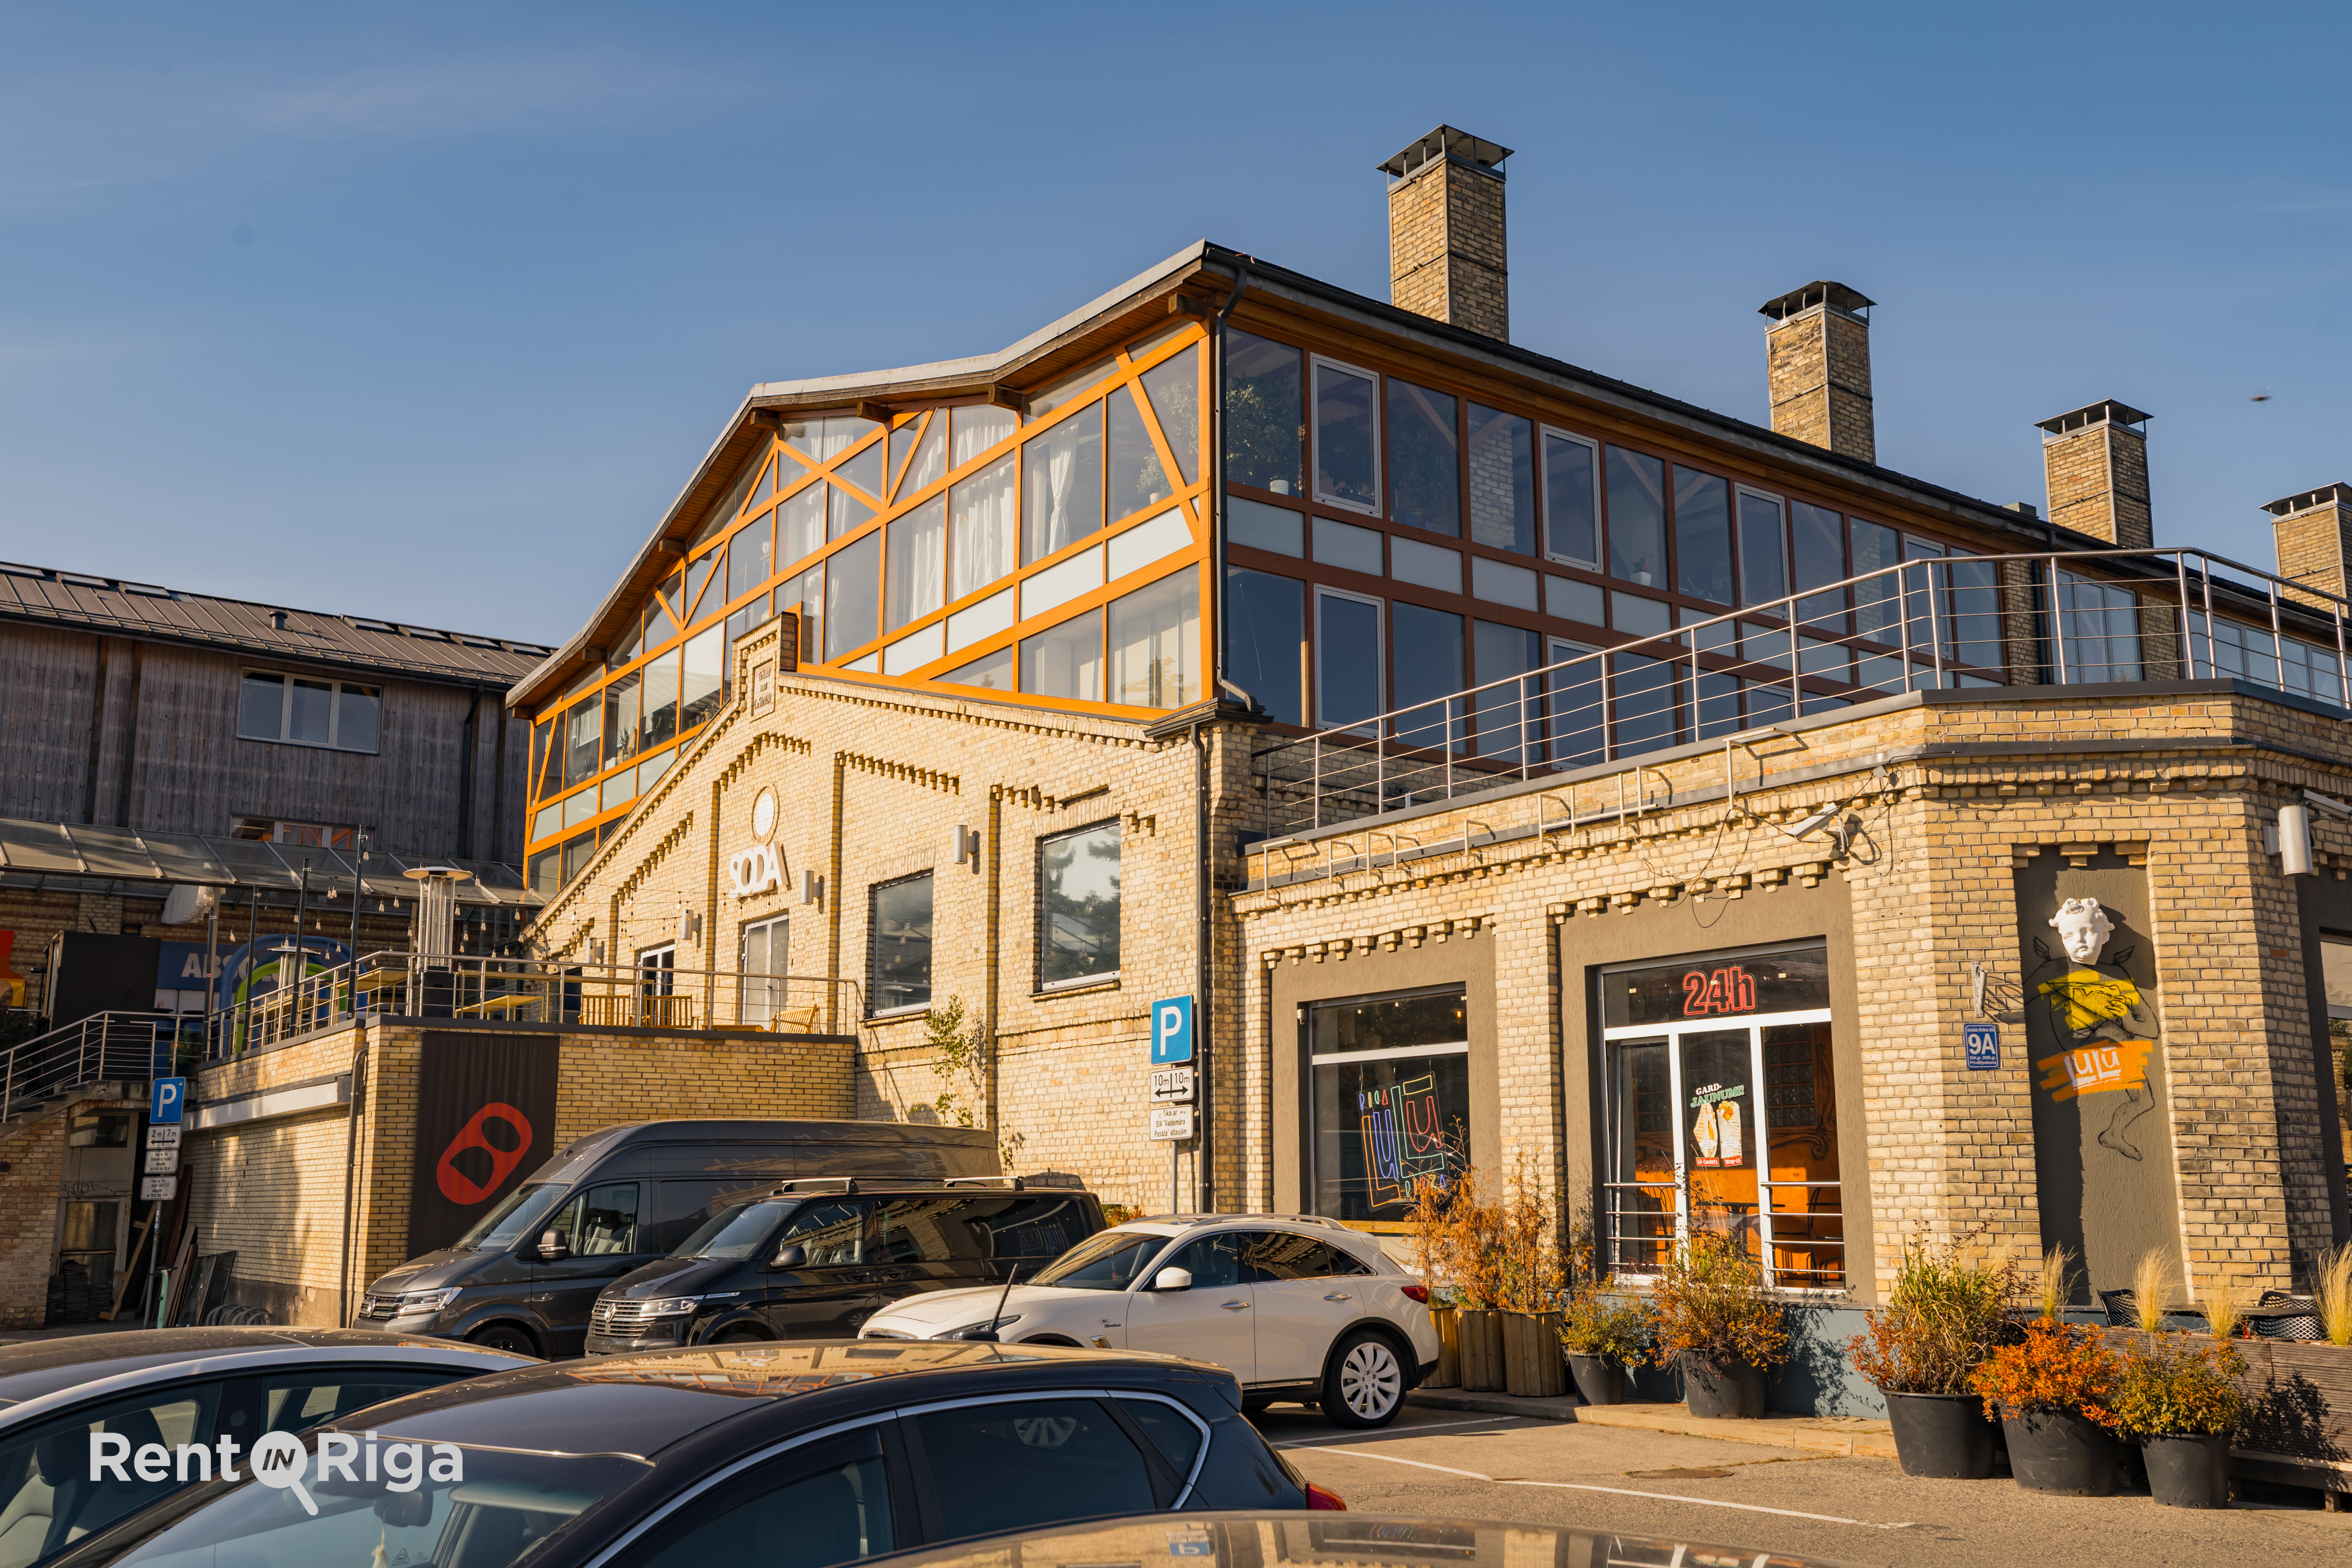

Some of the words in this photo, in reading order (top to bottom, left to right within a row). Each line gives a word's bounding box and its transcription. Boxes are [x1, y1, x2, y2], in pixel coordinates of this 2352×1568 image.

[728, 840, 787, 898] SODA
[1683, 966, 1756, 1016] 24h
[1160, 1006, 1182, 1056] P
[1968, 1033, 1996, 1055] 9A
[158, 1084, 177, 1118] P
[1690, 1085, 1745, 1108] JAUNUMI!
[1696, 1083, 1722, 1095] GARD-
